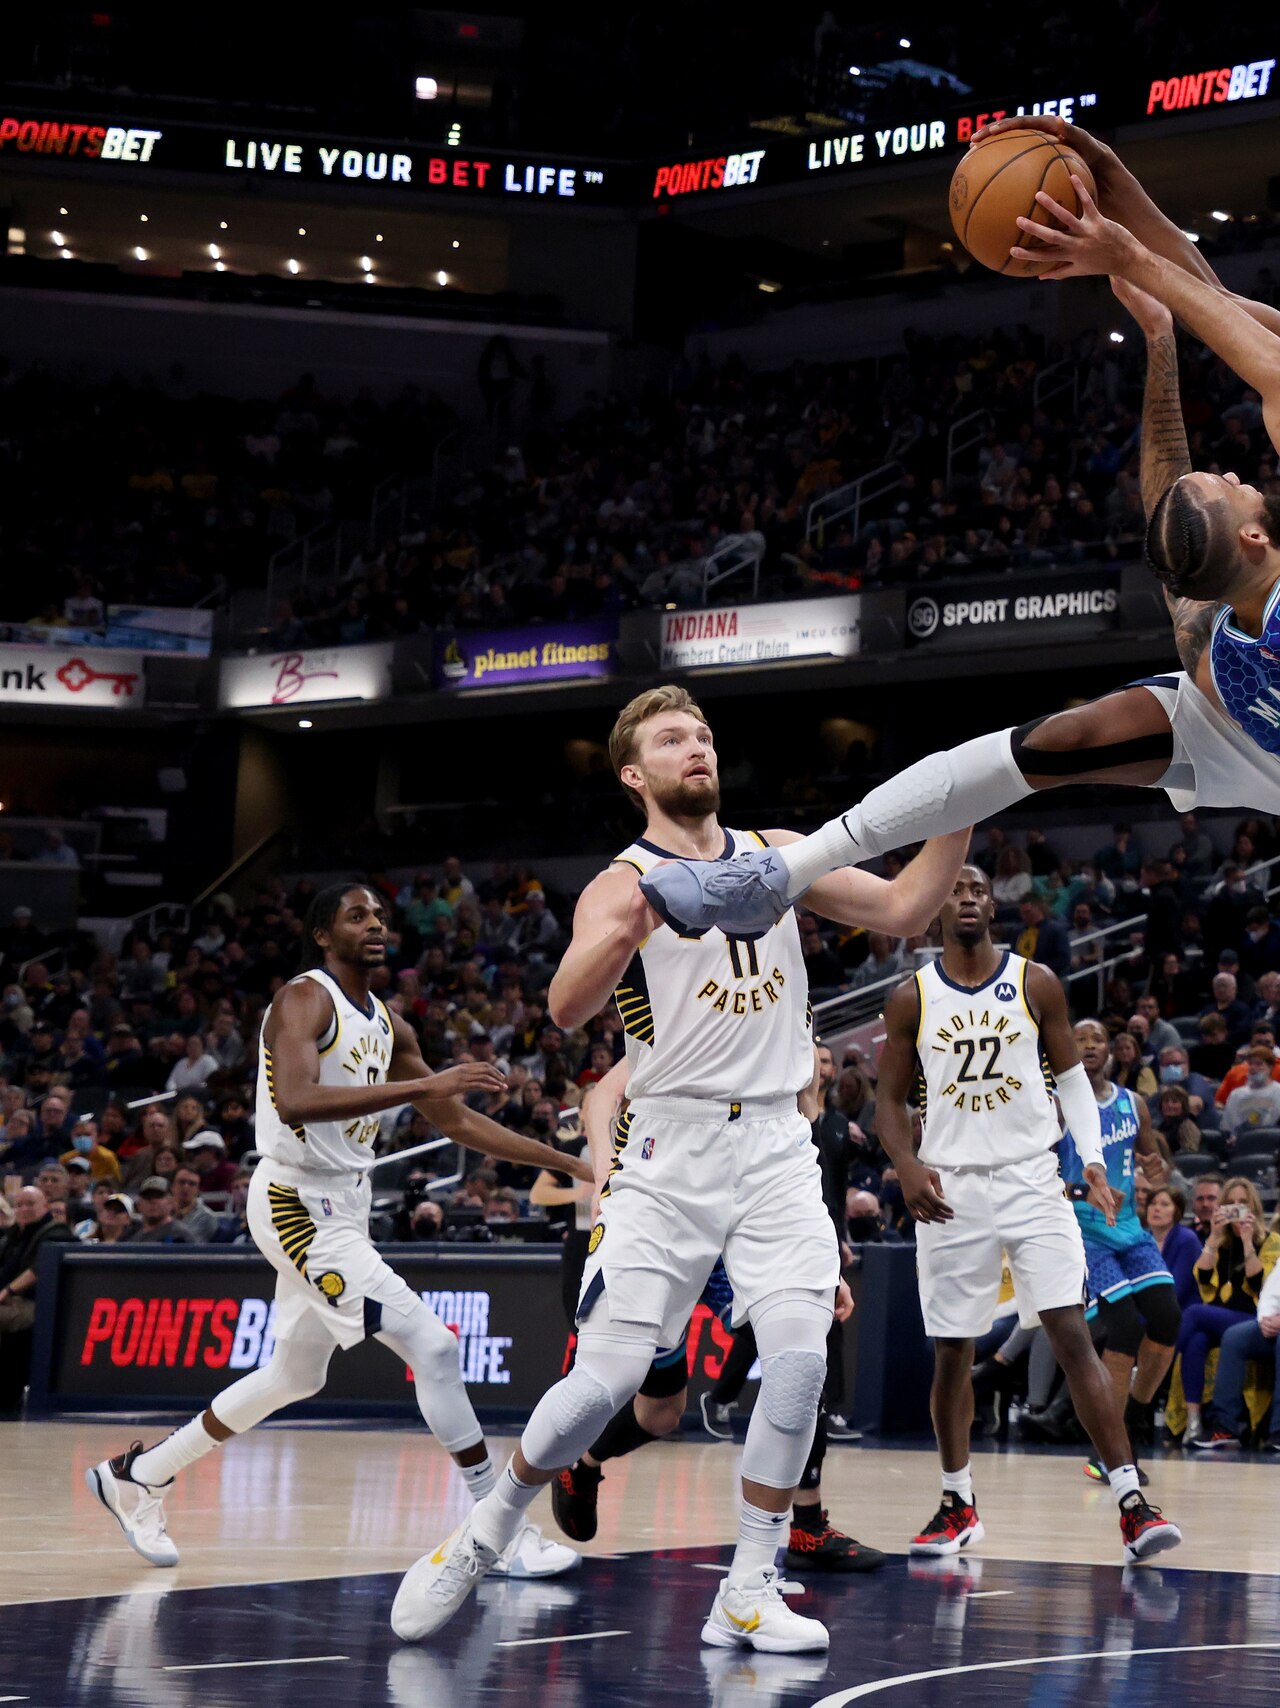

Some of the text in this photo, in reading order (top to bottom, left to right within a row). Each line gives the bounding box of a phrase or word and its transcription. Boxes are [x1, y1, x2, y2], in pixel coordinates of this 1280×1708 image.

[1147, 58, 1276, 115] POINTSBET
[0, 117, 162, 163] POINTSBET
[225, 138, 303, 173] LIVE
[318, 147, 412, 183] YOUR
[428, 158, 491, 188] BET
[808, 134, 866, 171] LIVE
[875, 120, 946, 158] YOUR
[653, 150, 766, 199] POINTSBET
[666, 611, 738, 643] INDIANA
[943, 599, 1009, 627] SPORT
[1014, 589, 1118, 620] GRAPHICS
[474, 642, 609, 679] planet fitness
[718, 642, 753, 662] Credit
[757, 638, 790, 659] Union
[697, 967, 786, 1016] PACERS
[931, 1009, 1021, 1053] INDIANA
[953, 1036, 1003, 1083] 22
[941, 1075, 1023, 1113] PACERS
